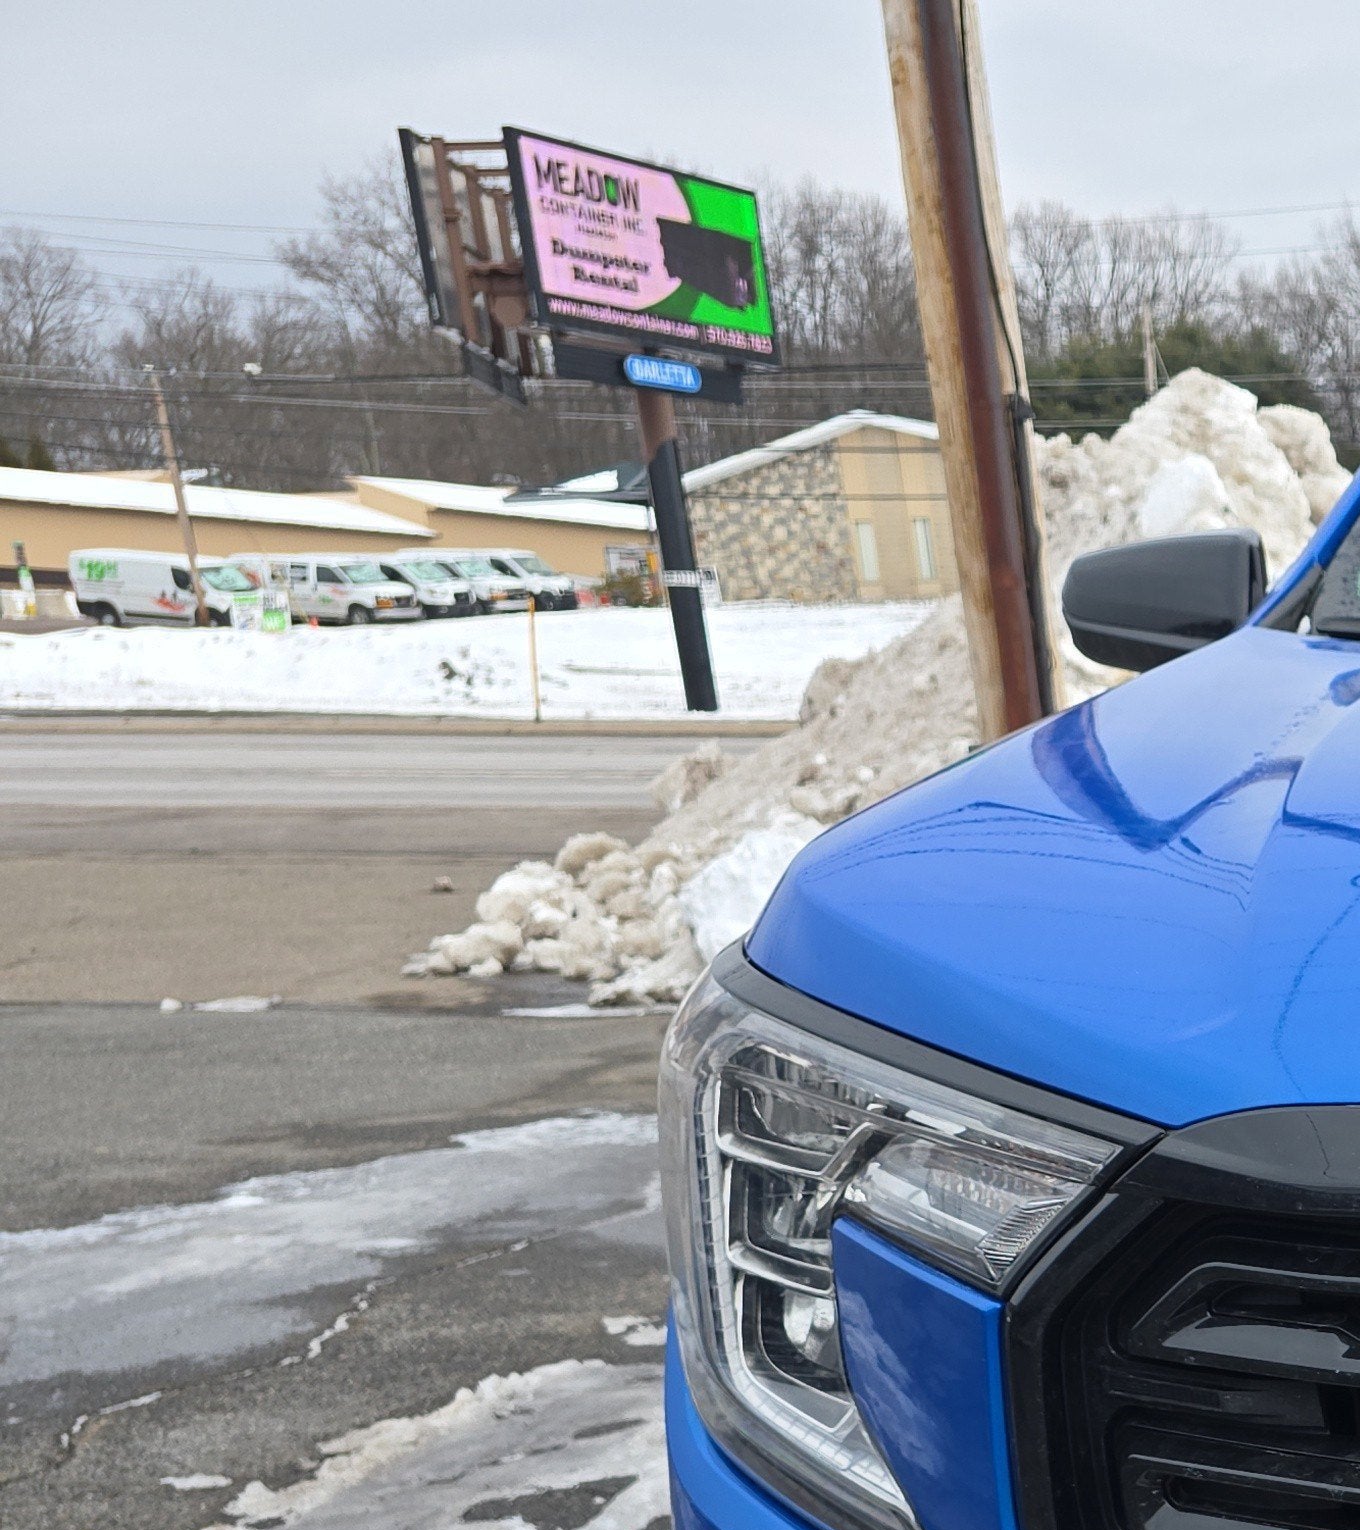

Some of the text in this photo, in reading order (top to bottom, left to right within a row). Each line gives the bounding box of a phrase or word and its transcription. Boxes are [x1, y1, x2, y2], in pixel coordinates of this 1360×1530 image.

[533, 153, 640, 212] MEADOW
[552, 236, 651, 274] Dumpster
[572, 263, 639, 292] Rental
